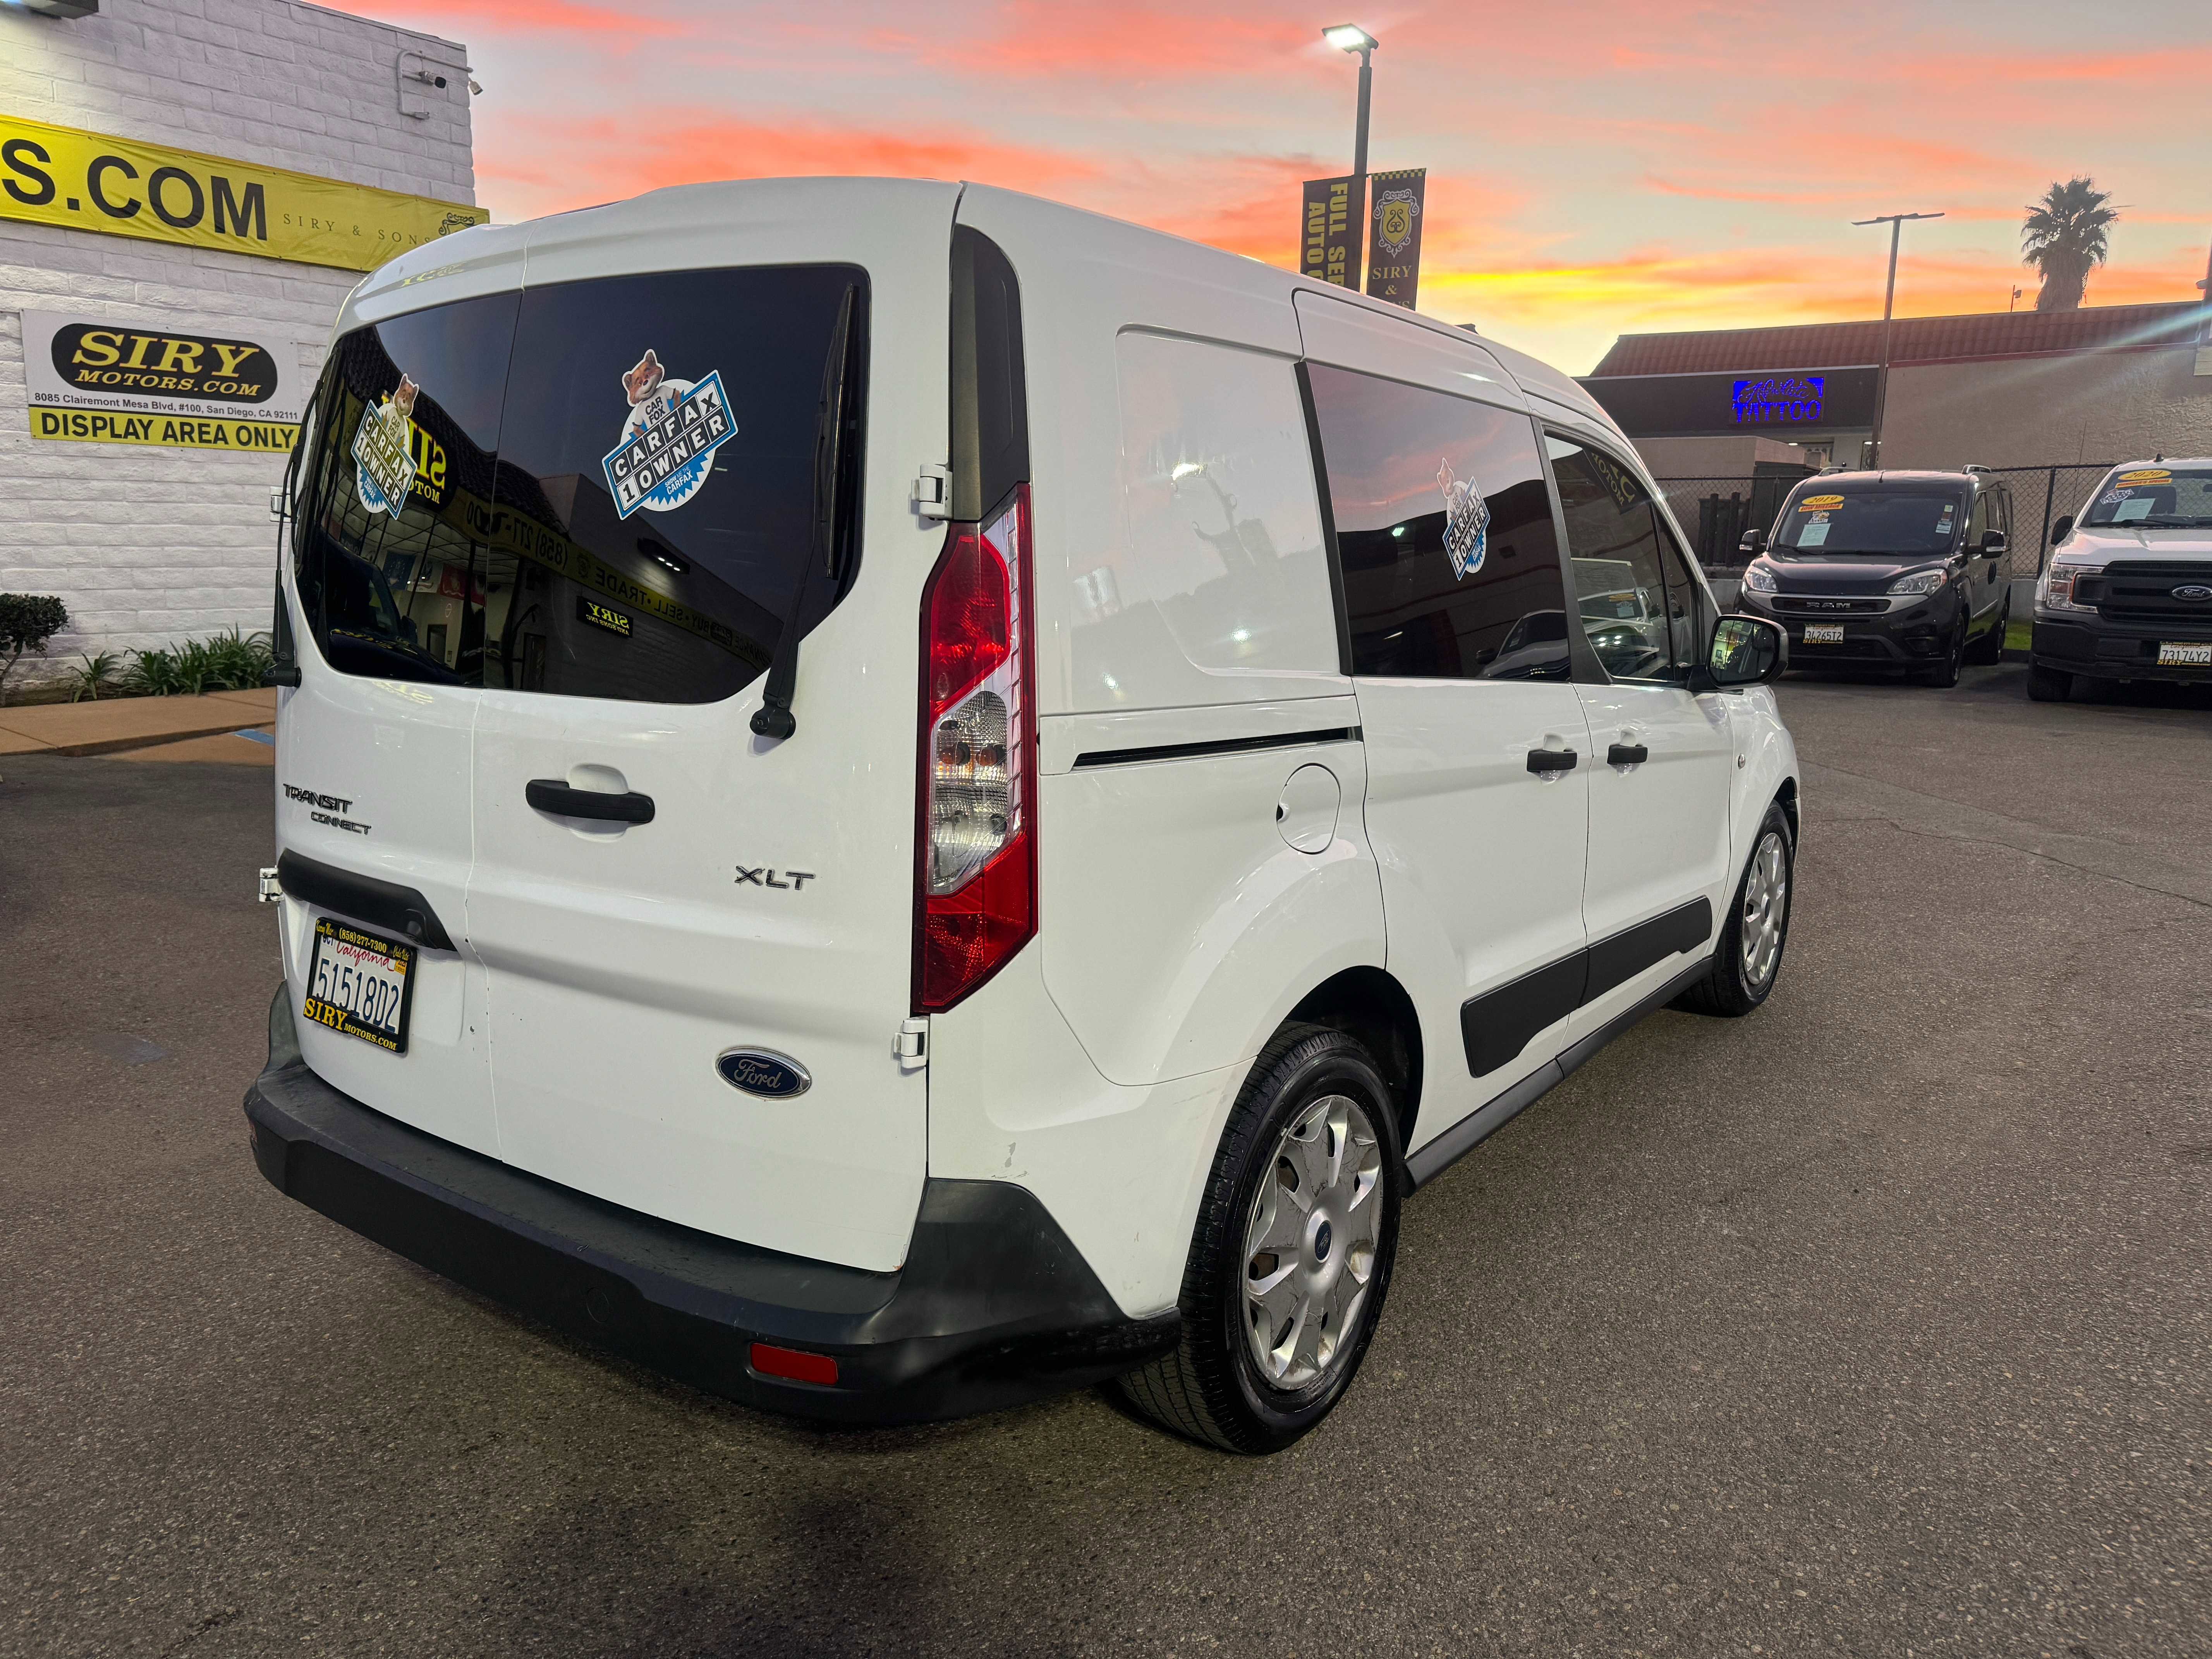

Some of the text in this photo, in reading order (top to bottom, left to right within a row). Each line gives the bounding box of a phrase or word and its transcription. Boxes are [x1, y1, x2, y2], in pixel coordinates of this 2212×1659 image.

[1329, 183, 1348, 236] FULL
[283, 213, 334, 232] SIRY
[352, 225, 361, 237] &
[1307, 202, 1326, 264] AUTO
[1372, 265, 1412, 279] SIRY
[1385, 285, 1397, 295] &
[72, 331, 259, 378] SIRY
[75, 369, 261, 396] MOTORS.COM
[35, 392, 297, 420] 8085 Clairemont Mesa Blvd, #100, San Diego, CA 92111
[645, 396, 663, 415] CAR
[649, 406, 665, 425] FOX
[1732, 400, 1821, 422] TATTOO
[41, 412, 294, 449] DISPLAY AREA ONLY
[388, 428, 397, 438] FOX
[391, 416, 400, 431] CAR
[615, 392, 716, 477] CARFAX
[364, 416, 409, 487] CARFAX
[639, 415, 725, 488] OWNER
[363, 448, 401, 507] OWNER
[665, 476, 677, 487] SHOW
[666, 471, 693, 495] CARFAX
[1449, 491, 1480, 550] CARFAX
[1461, 506, 1486, 558] OWNER
[2181, 589, 2205, 597] Ford
[2162, 650, 2209, 663] 73174Y2
[283, 783, 352, 814] TRANSIT
[311, 811, 371, 835] CONNECT
[735, 865, 816, 890] XLT
[339, 927, 356, 944] (858)
[357, 934, 387, 953] 277-7300
[337, 941, 395, 972] California
[304, 998, 397, 1051] SIRY MOTORS.COM
[734, 1058, 782, 1089] Ford
